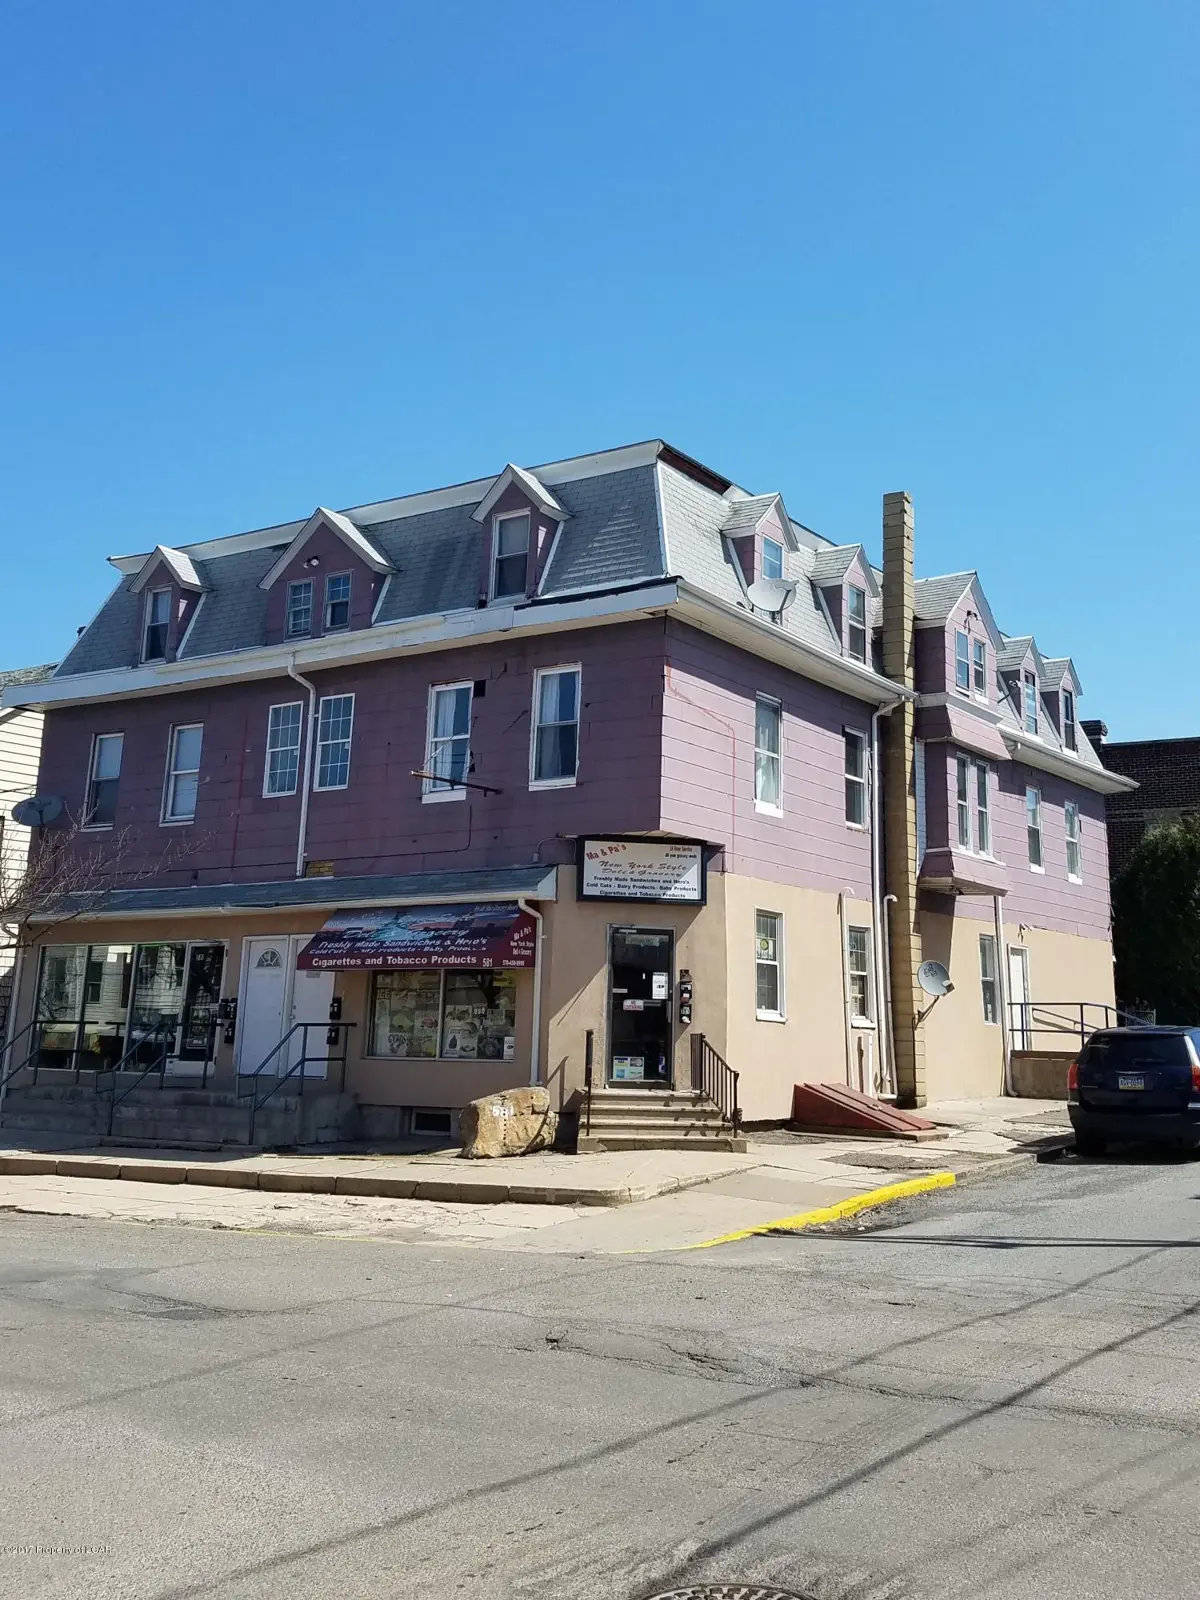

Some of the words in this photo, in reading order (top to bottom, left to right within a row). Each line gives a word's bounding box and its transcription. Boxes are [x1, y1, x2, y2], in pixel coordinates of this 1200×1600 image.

[586, 852, 599, 860] Ma
[600, 848, 608, 856] &
[608, 844, 627, 854] Pa's
[628, 862, 654, 870] York
[658, 863, 688, 871] Style
[638, 870, 682, 878] Grocery
[514, 932, 520, 940] Ma
[524, 926, 532, 936] Pa's
[319, 941, 354, 950] Freshly
[383, 938, 441, 946] Sandwiches
[521, 948, 532, 957] Grocery
[312, 958, 362, 967] Cigarettes
[386, 956, 428, 965] Tobacco
[431, 955, 478, 964] Products
[482, 958, 492, 967] 581
[493, 1105, 514, 1117] 581
